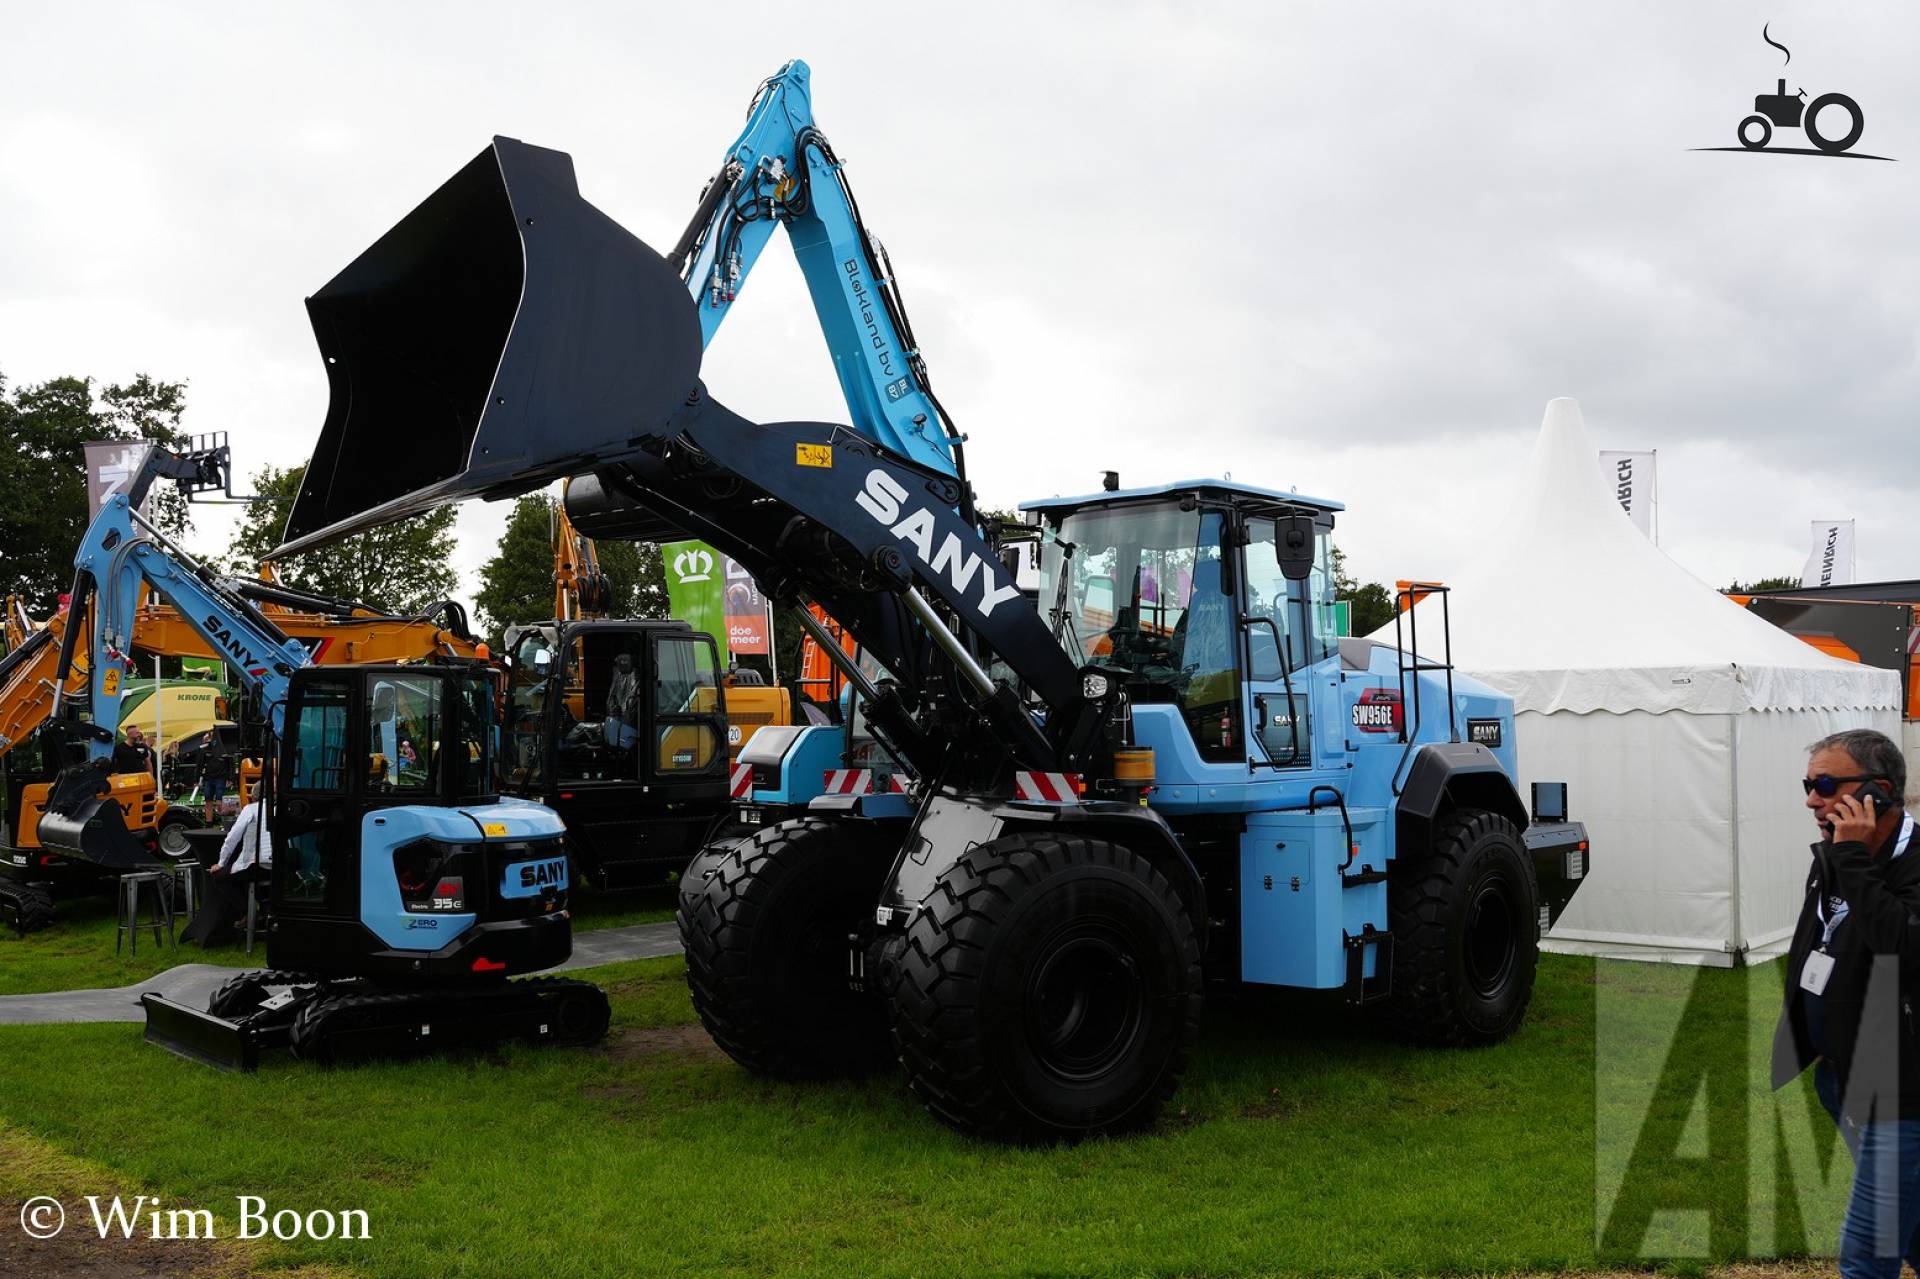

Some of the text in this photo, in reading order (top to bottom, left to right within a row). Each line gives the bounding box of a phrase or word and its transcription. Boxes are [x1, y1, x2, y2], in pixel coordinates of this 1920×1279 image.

[843, 258, 894, 377] Blokland bv
[854, 468, 1022, 617] SANY
[202, 615, 259, 668] SANY
[730, 625, 752, 635] doe
[730, 636, 760, 644] meer
[1352, 704, 1392, 725] SW956E
[1473, 725, 1499, 740] SANY
[520, 860, 565, 888] SANY
